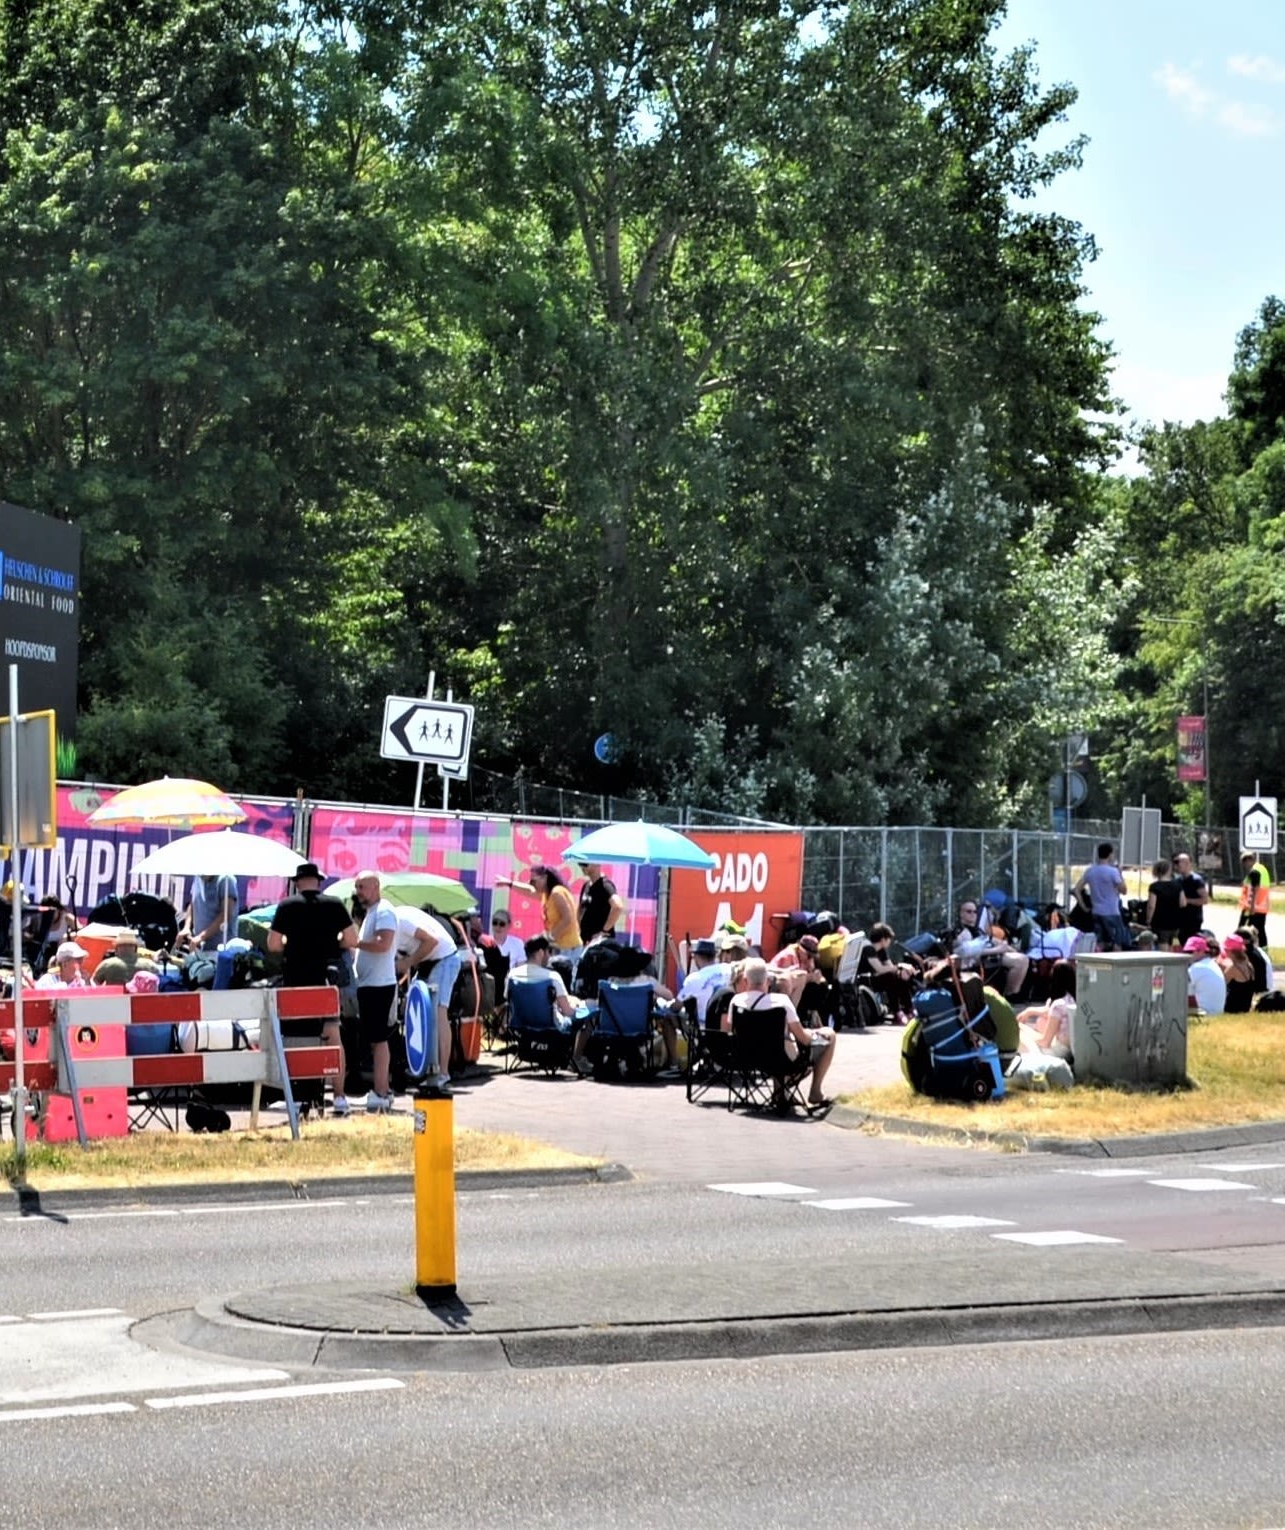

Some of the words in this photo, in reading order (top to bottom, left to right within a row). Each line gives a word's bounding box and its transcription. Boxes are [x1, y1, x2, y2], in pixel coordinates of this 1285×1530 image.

[4, 584, 44, 608] ORIENTAL
[51, 594, 74, 615] FOOD
[5, 638, 56, 662] HOOFDSPONSOR
[705, 852, 768, 894] CADO
